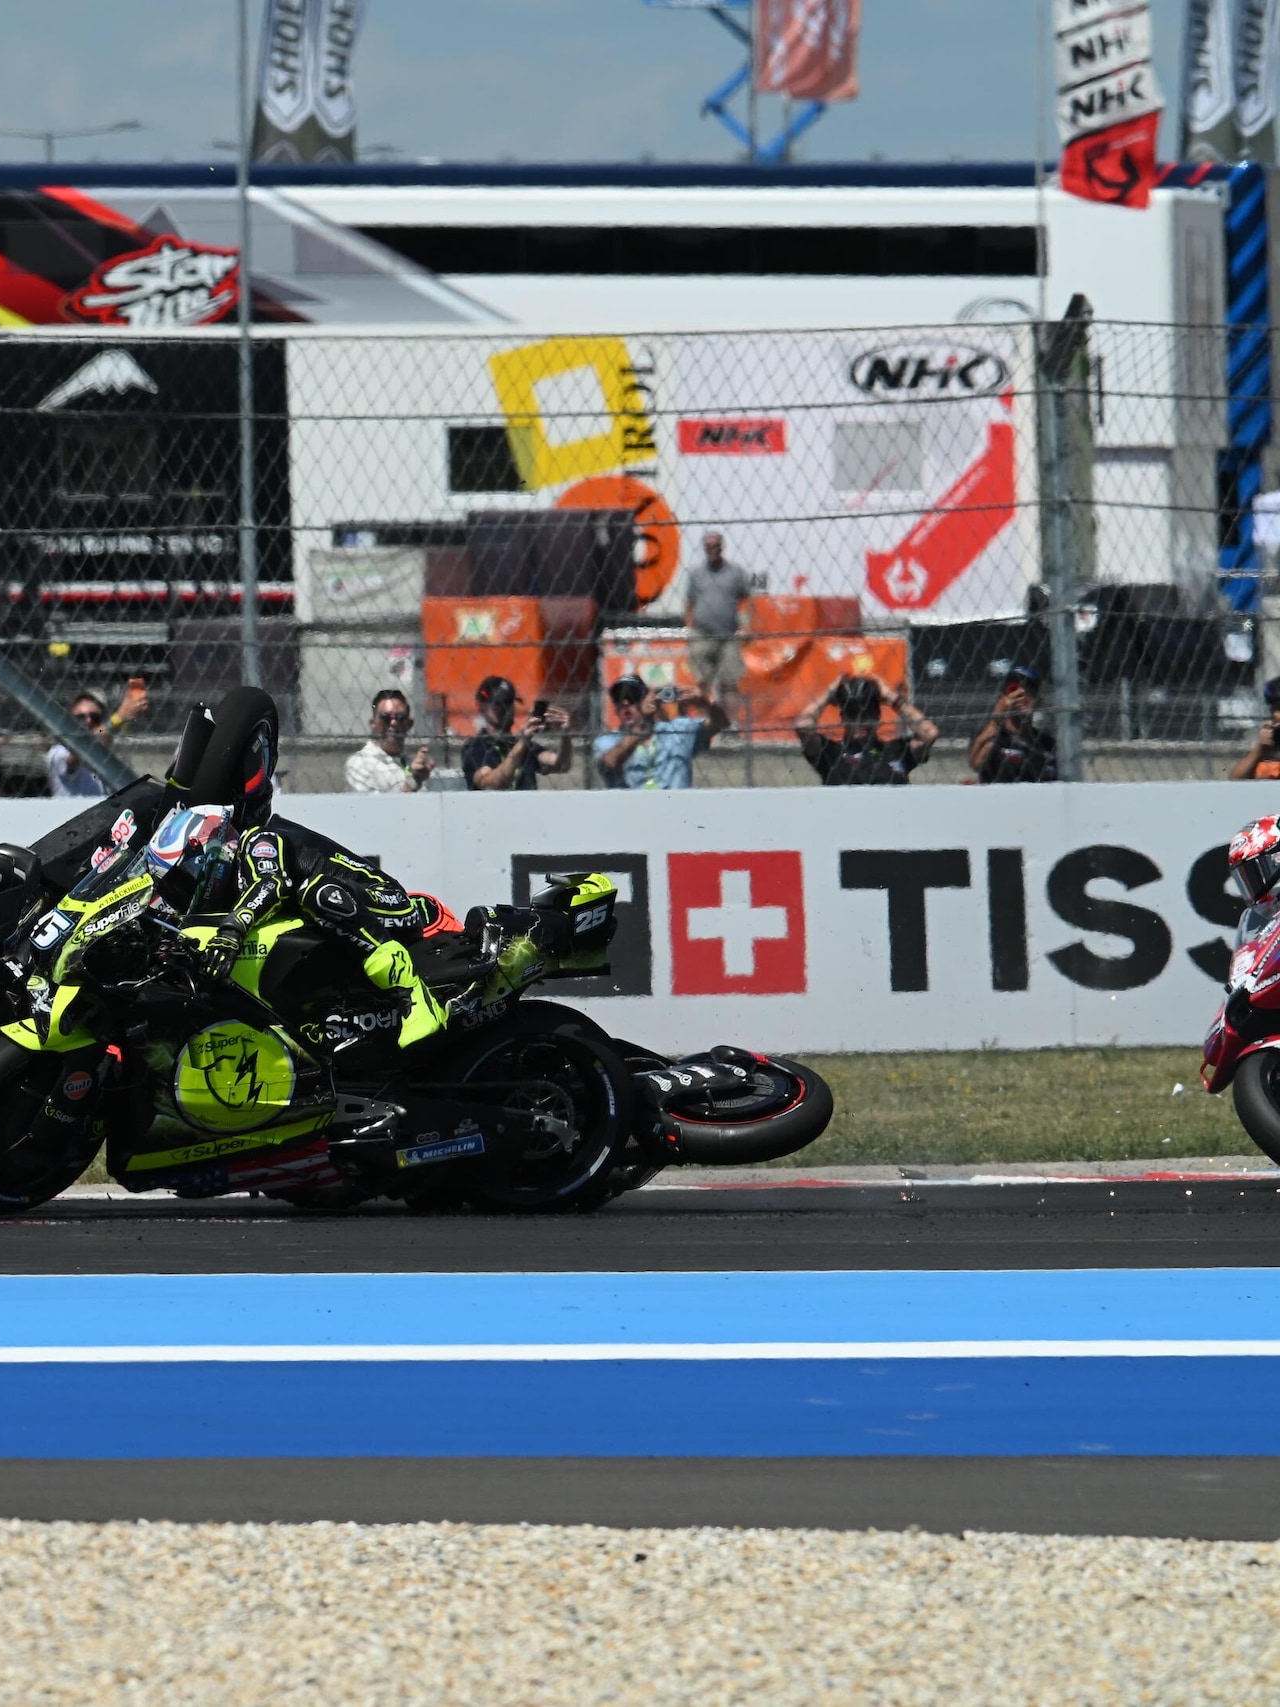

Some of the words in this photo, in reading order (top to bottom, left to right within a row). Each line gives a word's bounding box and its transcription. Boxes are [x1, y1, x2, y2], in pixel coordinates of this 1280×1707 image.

[1070, 72, 1147, 124] NHK
[863, 355, 990, 391] NHK
[84, 900, 141, 937] SuperFile
[572, 903, 608, 934] 25
[421, 1141, 476, 1160] MICHELIN
